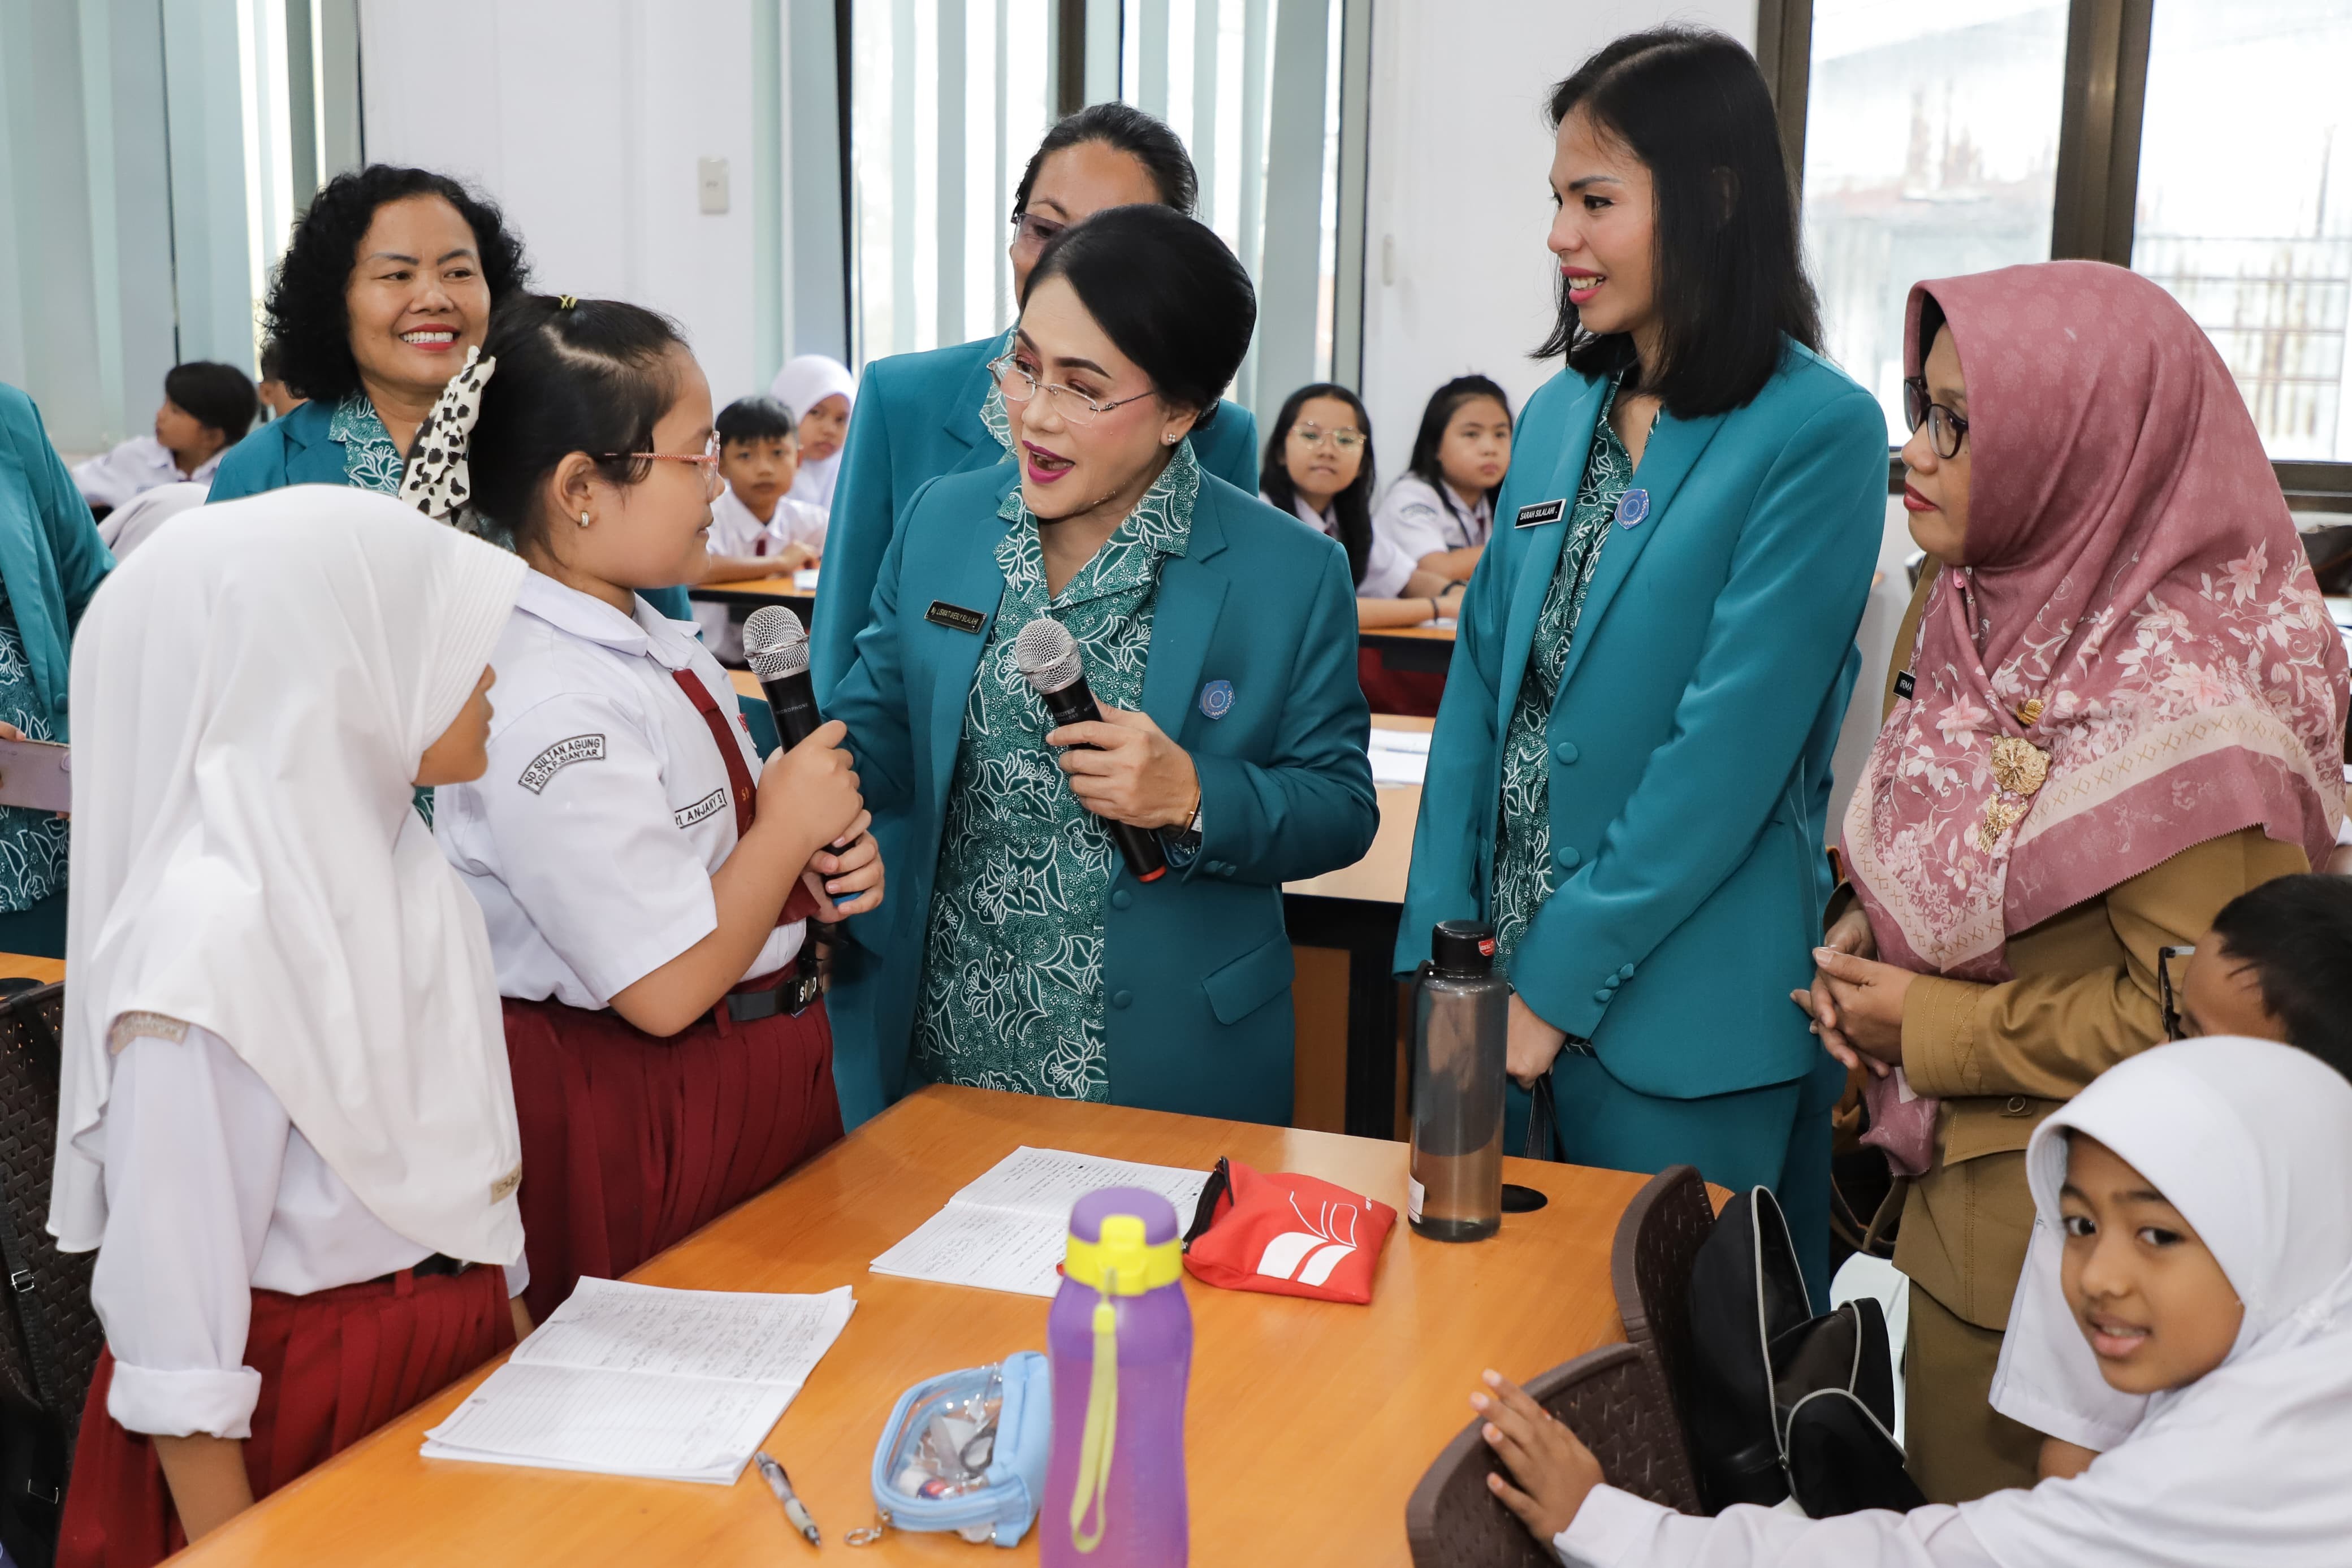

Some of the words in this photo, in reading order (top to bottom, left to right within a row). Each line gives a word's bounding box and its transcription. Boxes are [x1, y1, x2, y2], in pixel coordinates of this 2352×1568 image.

[1520, 510, 1535, 520] SARAH
[1535, 506, 1556, 517] SILALAHI
[1900, 679, 1912, 692] IRMA
[525, 771, 537, 785] SD
[534, 744, 565, 772] SULTAN
[568, 738, 600, 751] AGUNG
[687, 797, 717, 821] ANJANY
[717, 794, 723, 803] S
